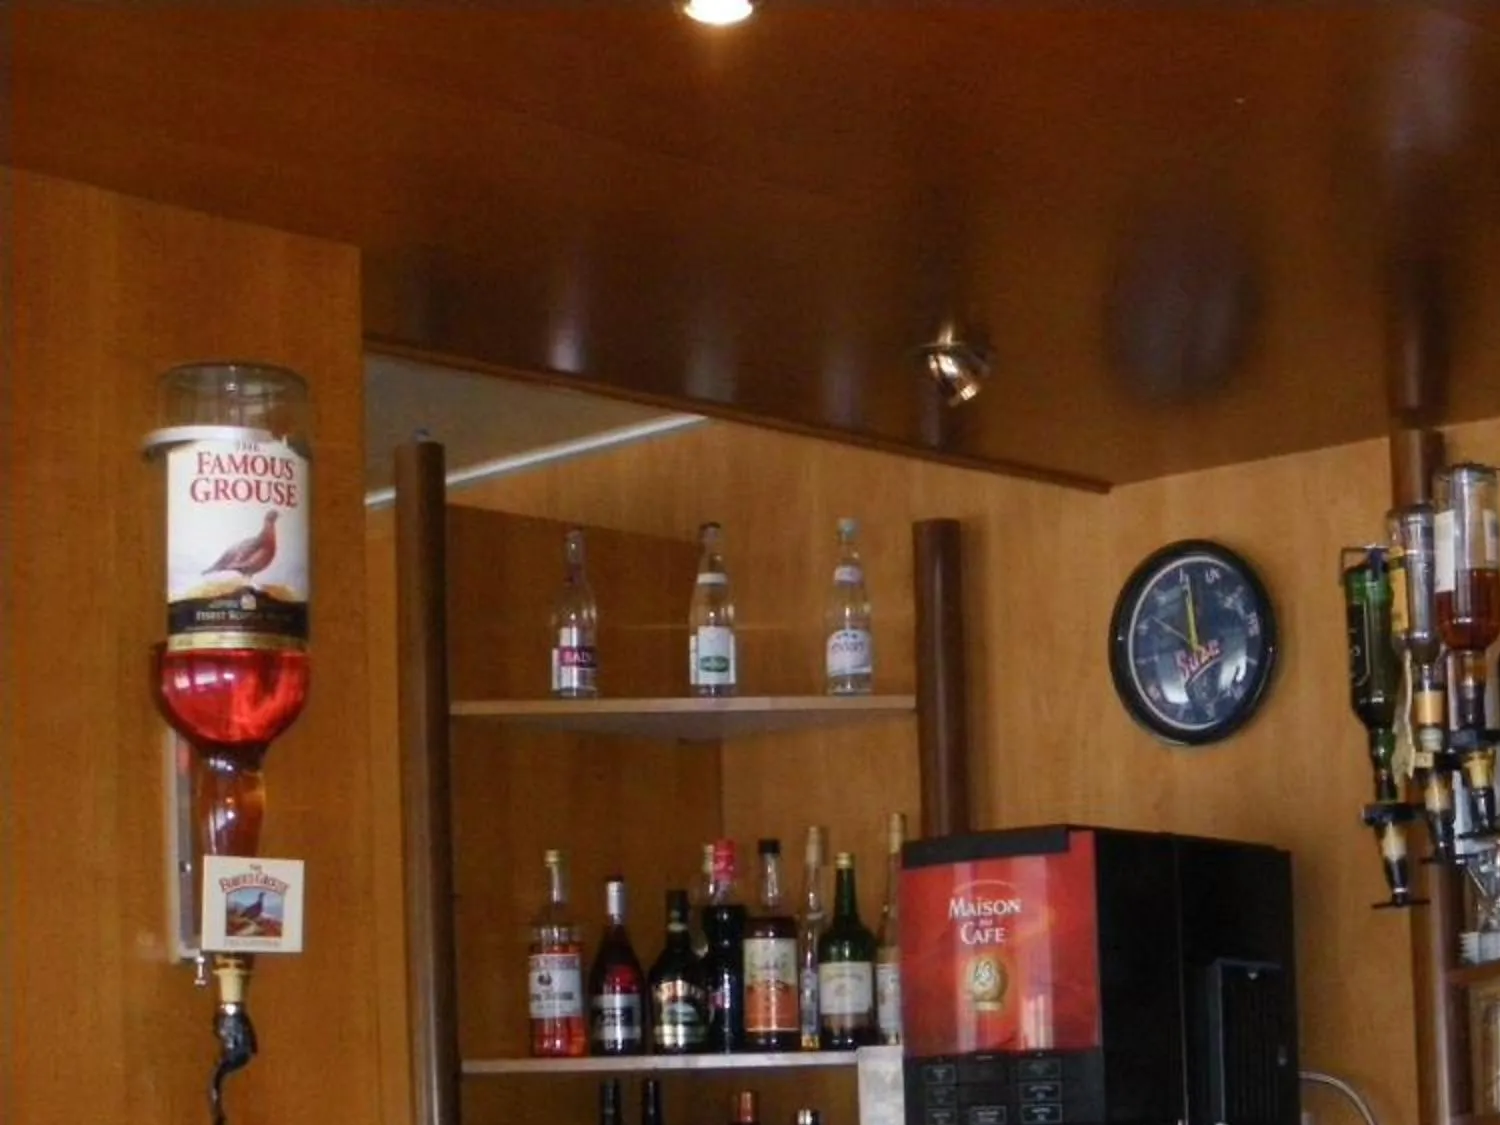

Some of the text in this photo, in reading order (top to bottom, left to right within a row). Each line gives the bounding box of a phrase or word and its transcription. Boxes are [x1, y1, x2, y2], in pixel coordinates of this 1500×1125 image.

[196, 451, 294, 481] FAMOUS
[189, 477, 298, 507] GROUSE
[948, 896, 1022, 921] MAISON
